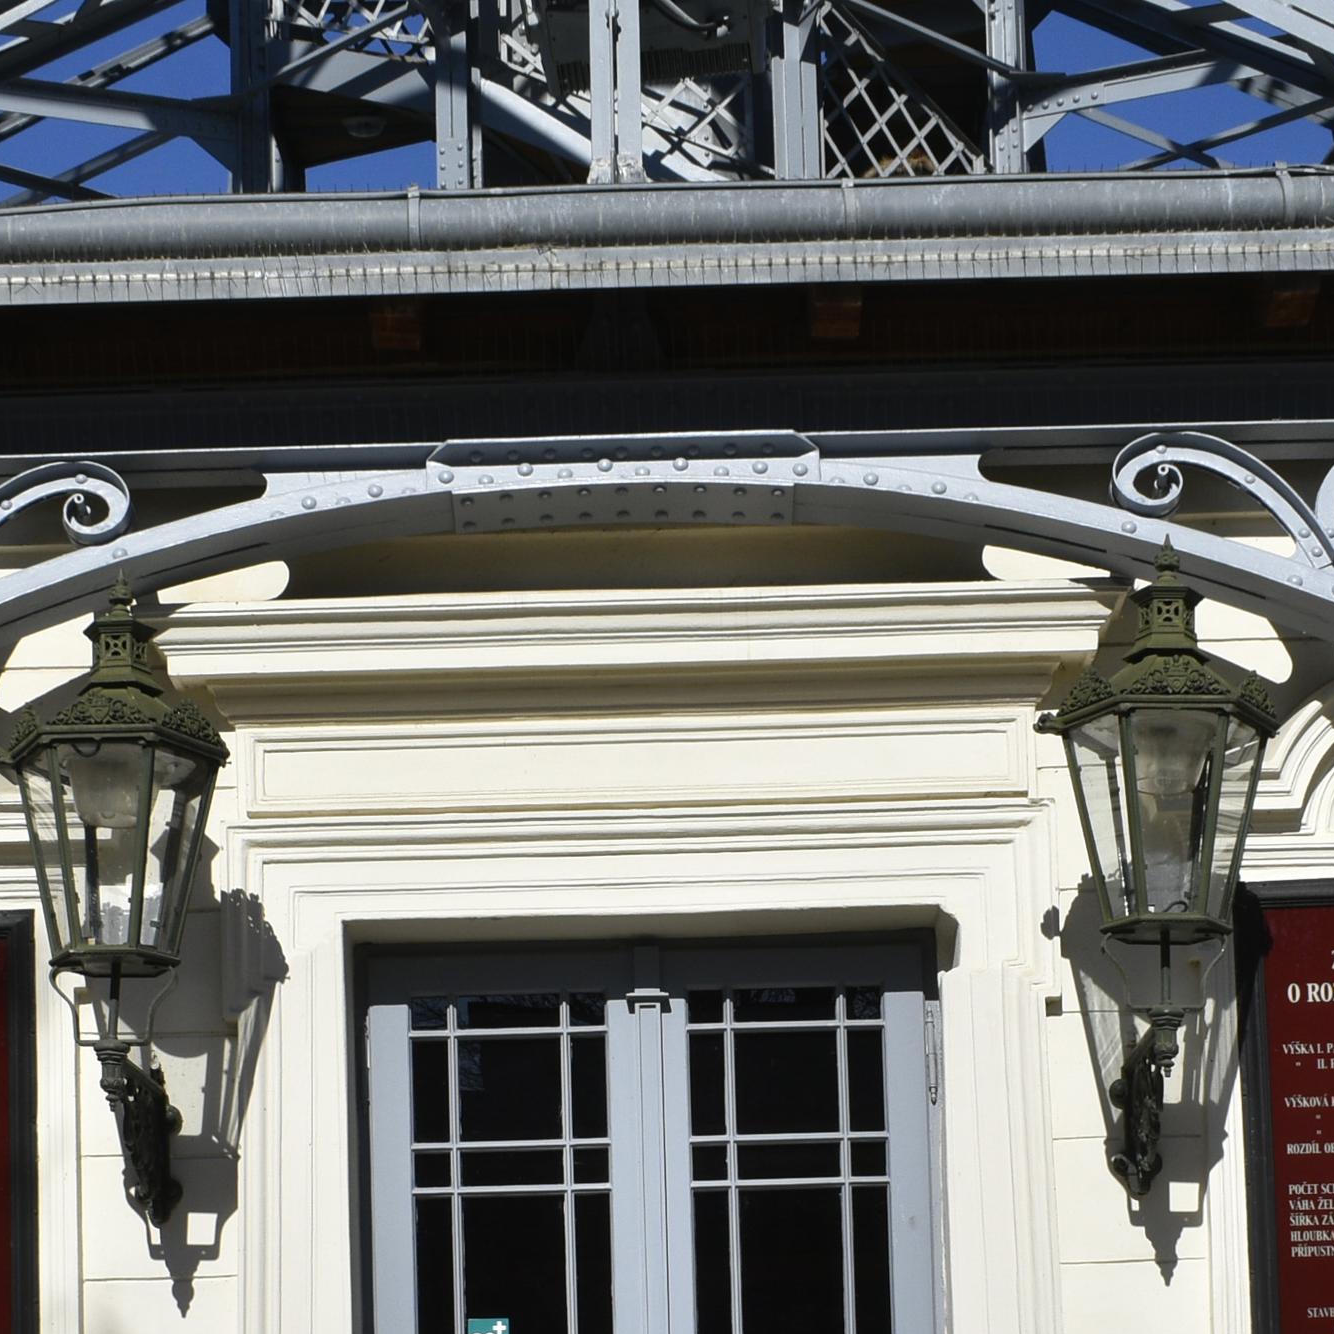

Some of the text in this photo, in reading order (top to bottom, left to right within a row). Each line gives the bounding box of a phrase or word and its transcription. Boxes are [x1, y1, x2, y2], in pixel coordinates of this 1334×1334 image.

[1287, 983, 1301, 1003] O
[1283, 1040, 1315, 1054] VÝŠKA
[1284, 1094, 1329, 1107] VÝŠKOVÁ
[1287, 1140, 1322, 1154] ROZDÍL
[1289, 1181, 1319, 1195] POČET
[1289, 1197, 1316, 1210] VÁHA
[1290, 1213, 1320, 1226] ŠÍŘKA
